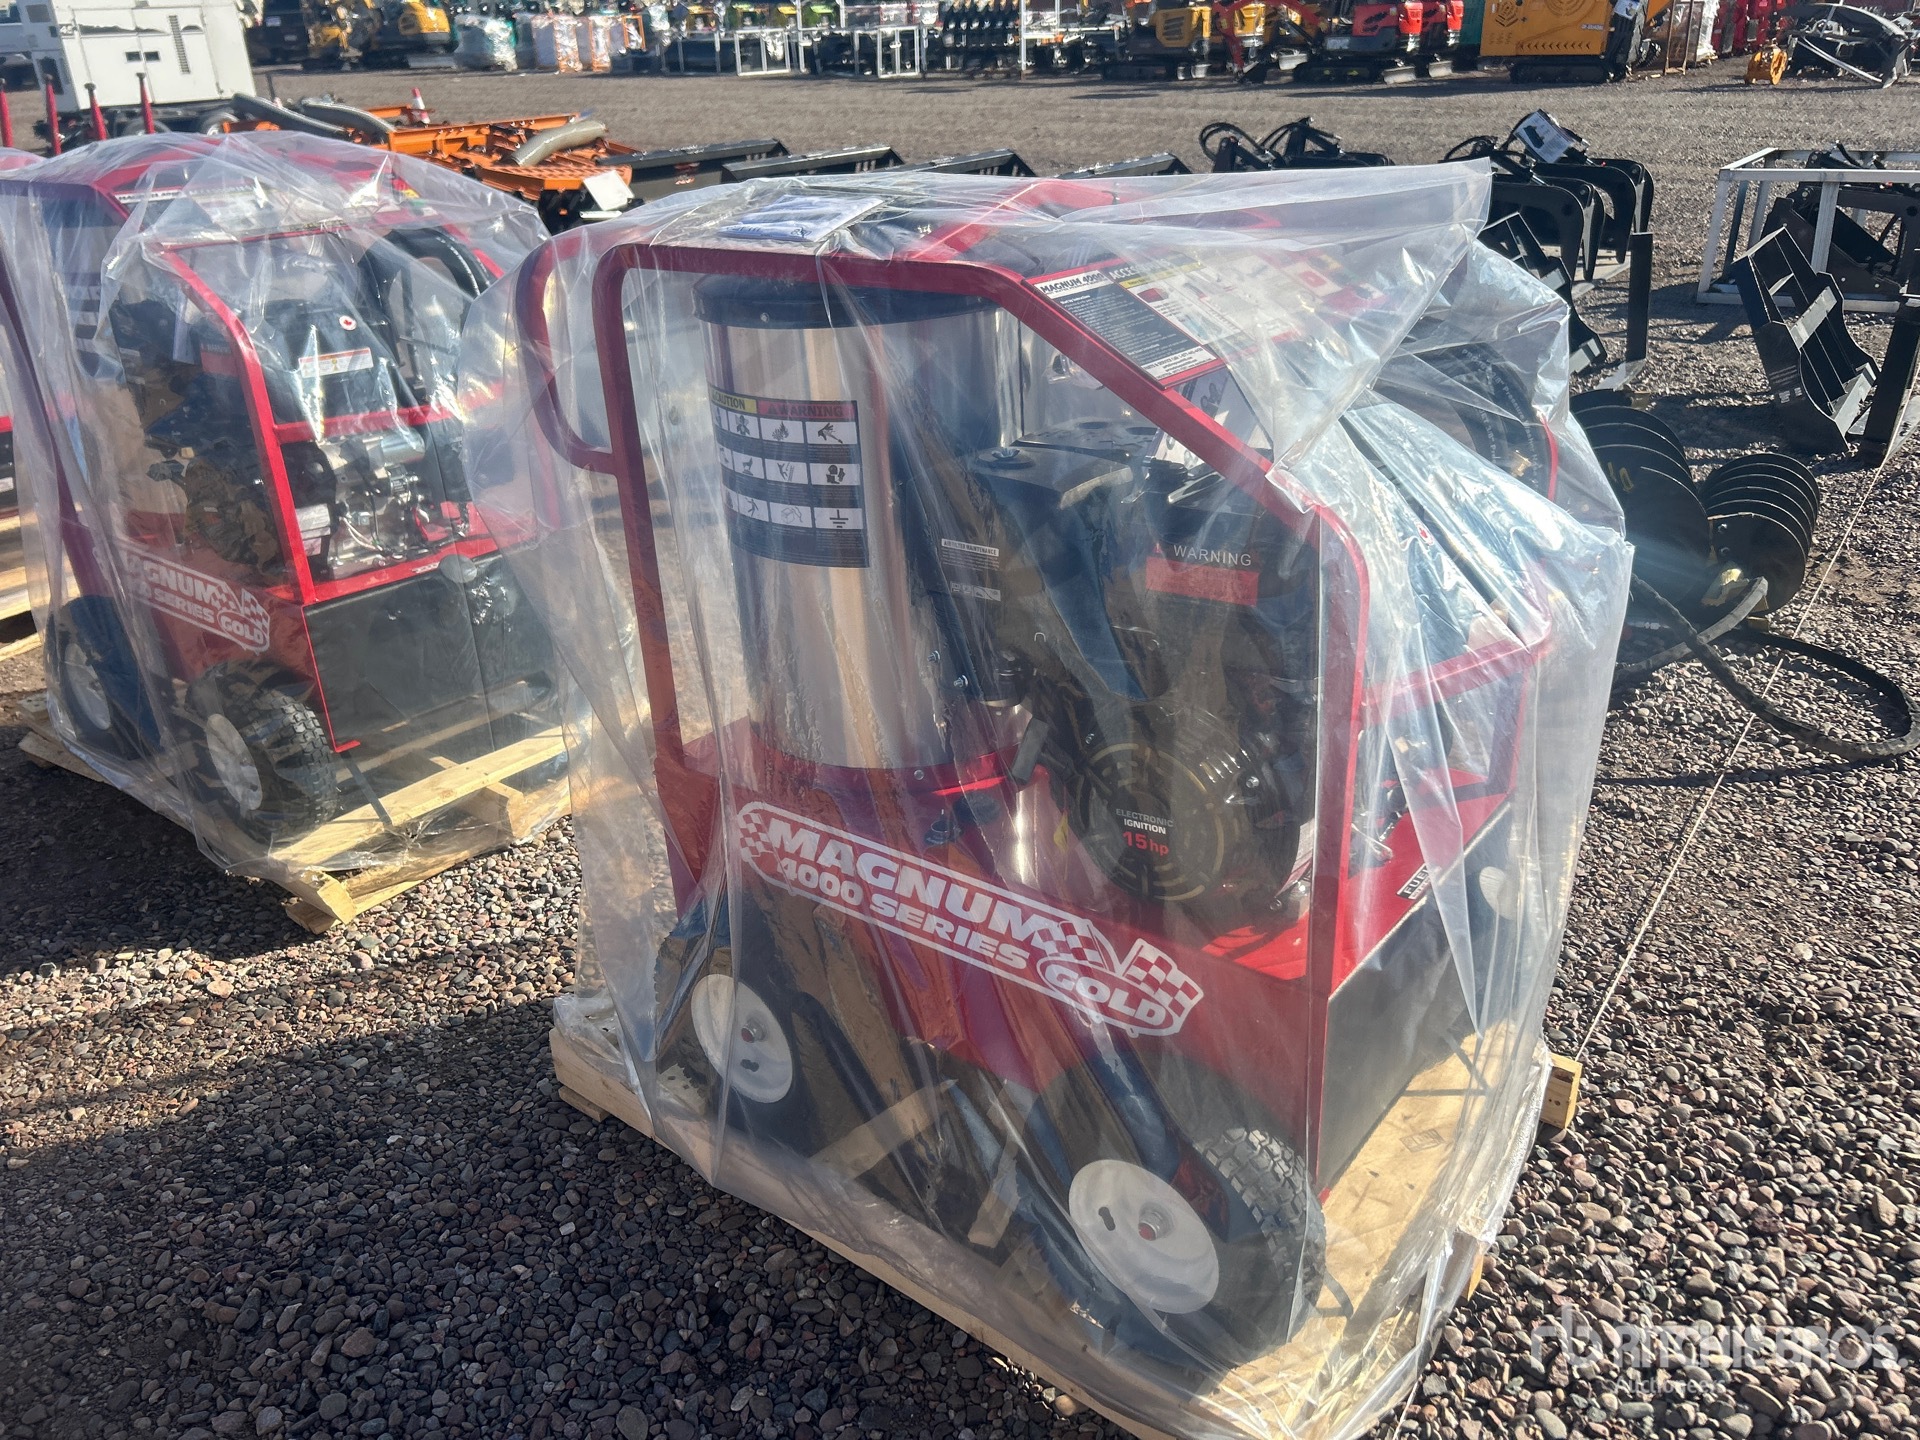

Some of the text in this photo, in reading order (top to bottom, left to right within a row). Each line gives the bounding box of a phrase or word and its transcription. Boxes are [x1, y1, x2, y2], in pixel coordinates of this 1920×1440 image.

[1040, 278, 1082, 292] MAGNUM
[783, 404, 844, 417] WARNING
[966, 544, 997, 555] MAINTENANCE
[1173, 544, 1252, 567] WARNING
[153, 588, 215, 623] SERIES
[220, 616, 264, 645] GOLD
[1115, 808, 1175, 828] ELECTRONIC
[1123, 818, 1167, 835] IGNITION
[766, 816, 1050, 950] MAGNUM
[777, 857, 1030, 970] 4000 SERIES
[1044, 963, 1167, 1026] GOLD
